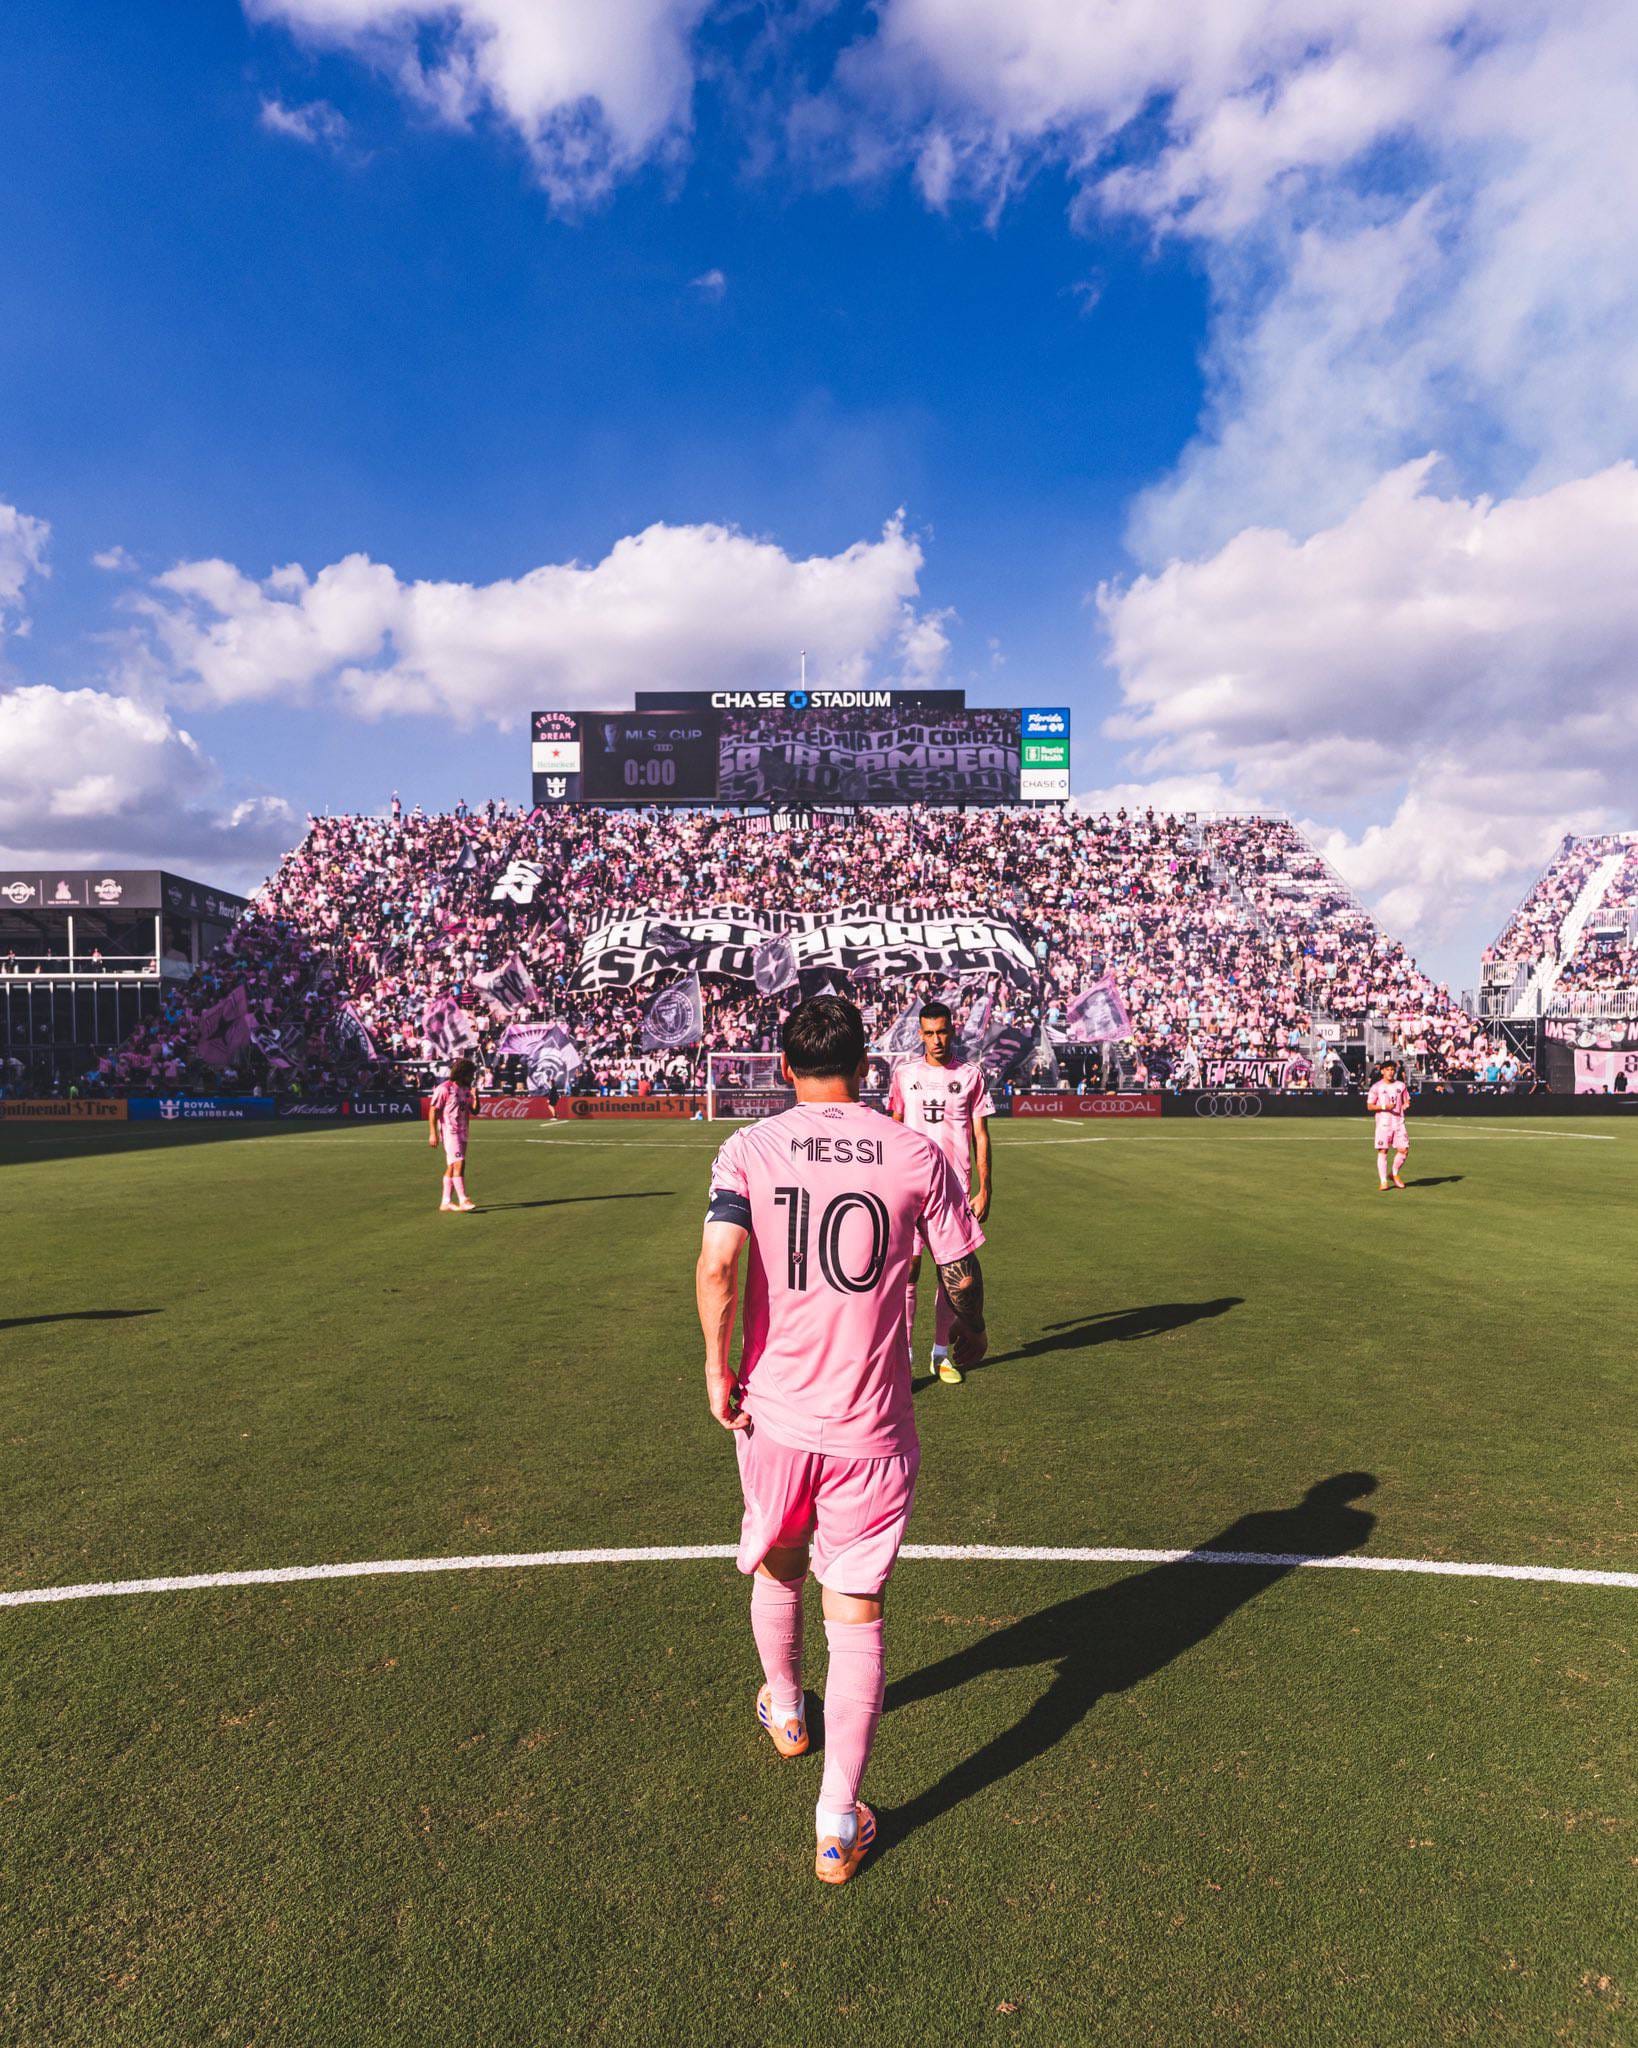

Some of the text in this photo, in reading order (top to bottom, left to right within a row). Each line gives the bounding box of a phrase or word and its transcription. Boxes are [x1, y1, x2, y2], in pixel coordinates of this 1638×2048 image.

[711, 692, 891, 709] CHASE STADIUM
[535, 713, 576, 729] FREEDOM
[551, 723, 561, 731] TO
[540, 732, 571, 740] DREAM
[625, 729, 702, 739] MLS CUP
[624, 759, 675, 785] 0:00
[1022, 780, 1055, 788] CHASE
[0, 1101, 118, 1120] ontinental Tire
[354, 1103, 413, 1114] ULTRA
[570, 1099, 661, 1115] Continental
[1019, 1101, 1064, 1112] Audi
[791, 1137, 883, 1165] MESSI
[774, 1186, 890, 1295] 10
